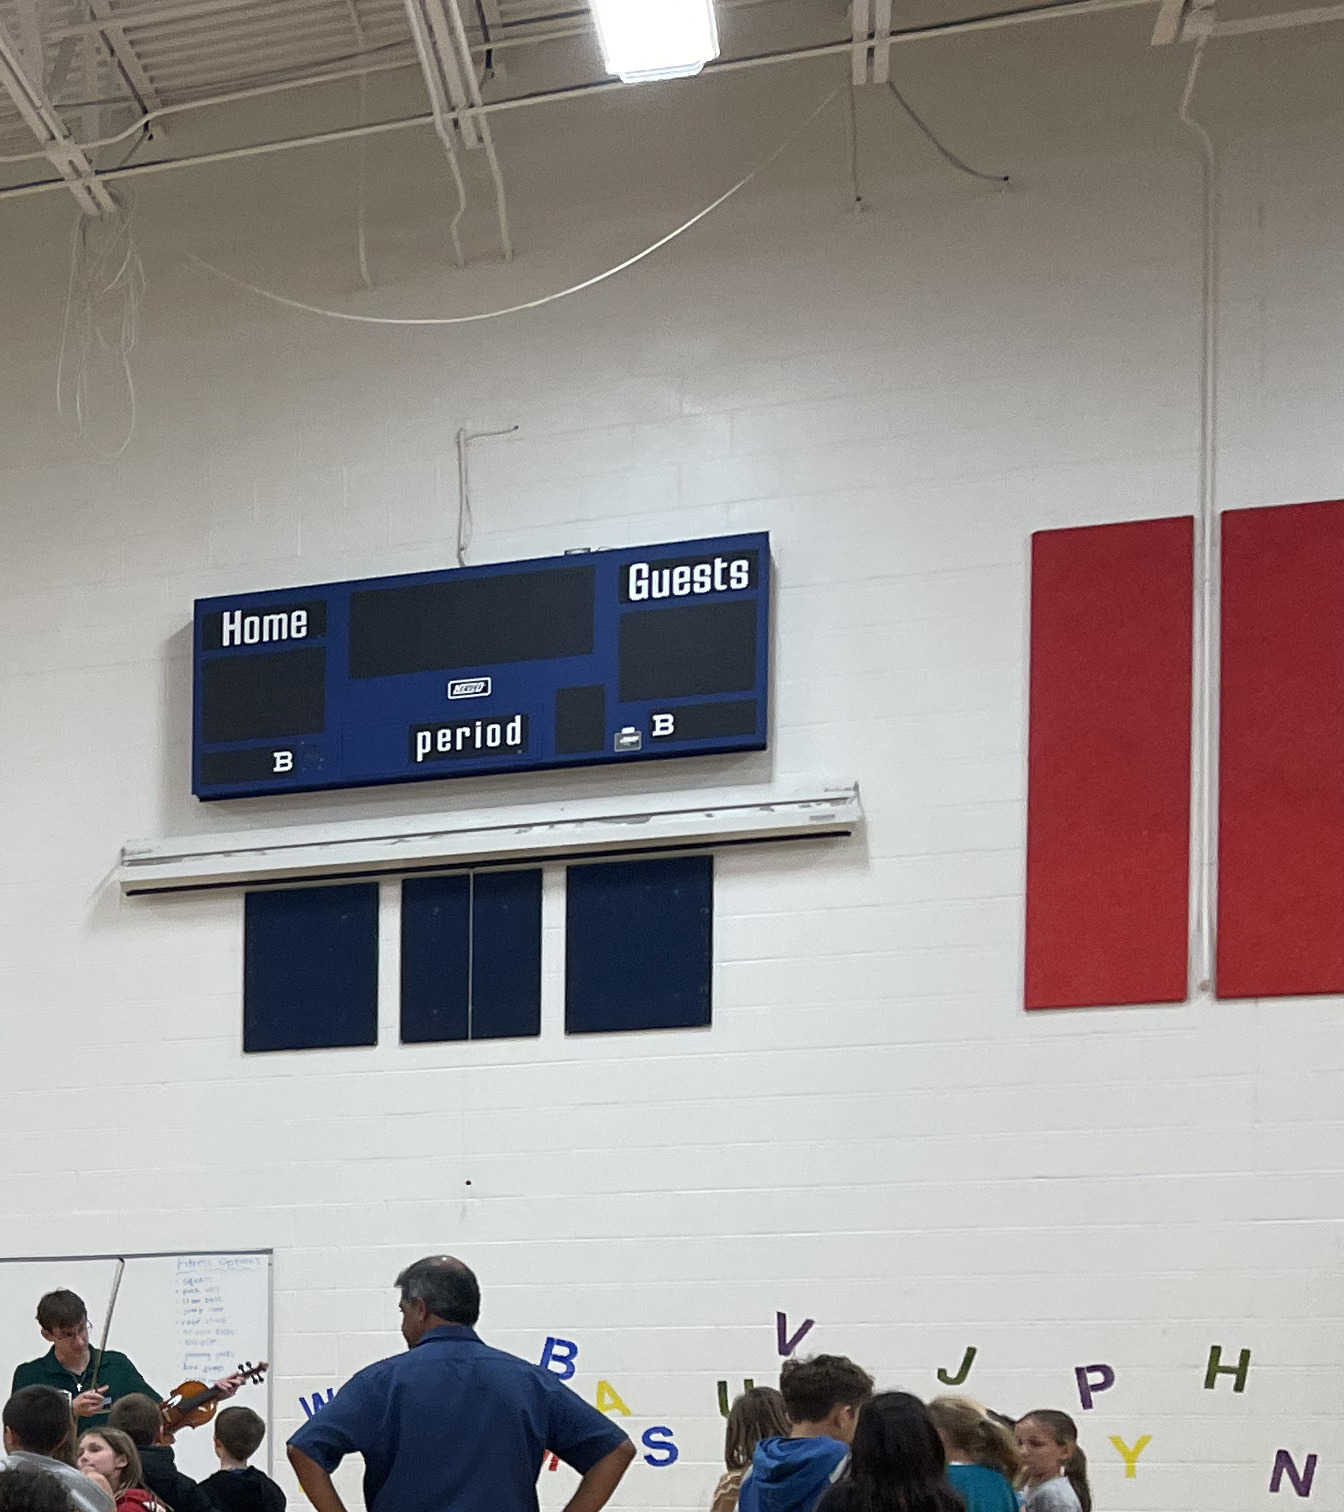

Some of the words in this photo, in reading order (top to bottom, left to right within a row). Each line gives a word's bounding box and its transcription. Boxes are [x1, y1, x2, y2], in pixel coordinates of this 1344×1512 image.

[628, 557, 750, 601] Guests
[222, 609, 308, 647] Home
[416, 715, 523, 762] period
[652, 714, 675, 737] B
[273, 751, 293, 773] B
[776, 1311, 815, 1357] V
[539, 1336, 579, 1381] B
[937, 1346, 977, 1386] J
[1204, 1345, 1252, 1394] H
[595, 1380, 633, 1417] A
[1075, 1363, 1115, 1411] P
[641, 1426, 680, 1468] S
[1108, 1434, 1152, 1479] Y
[1269, 1449, 1318, 1498] N
